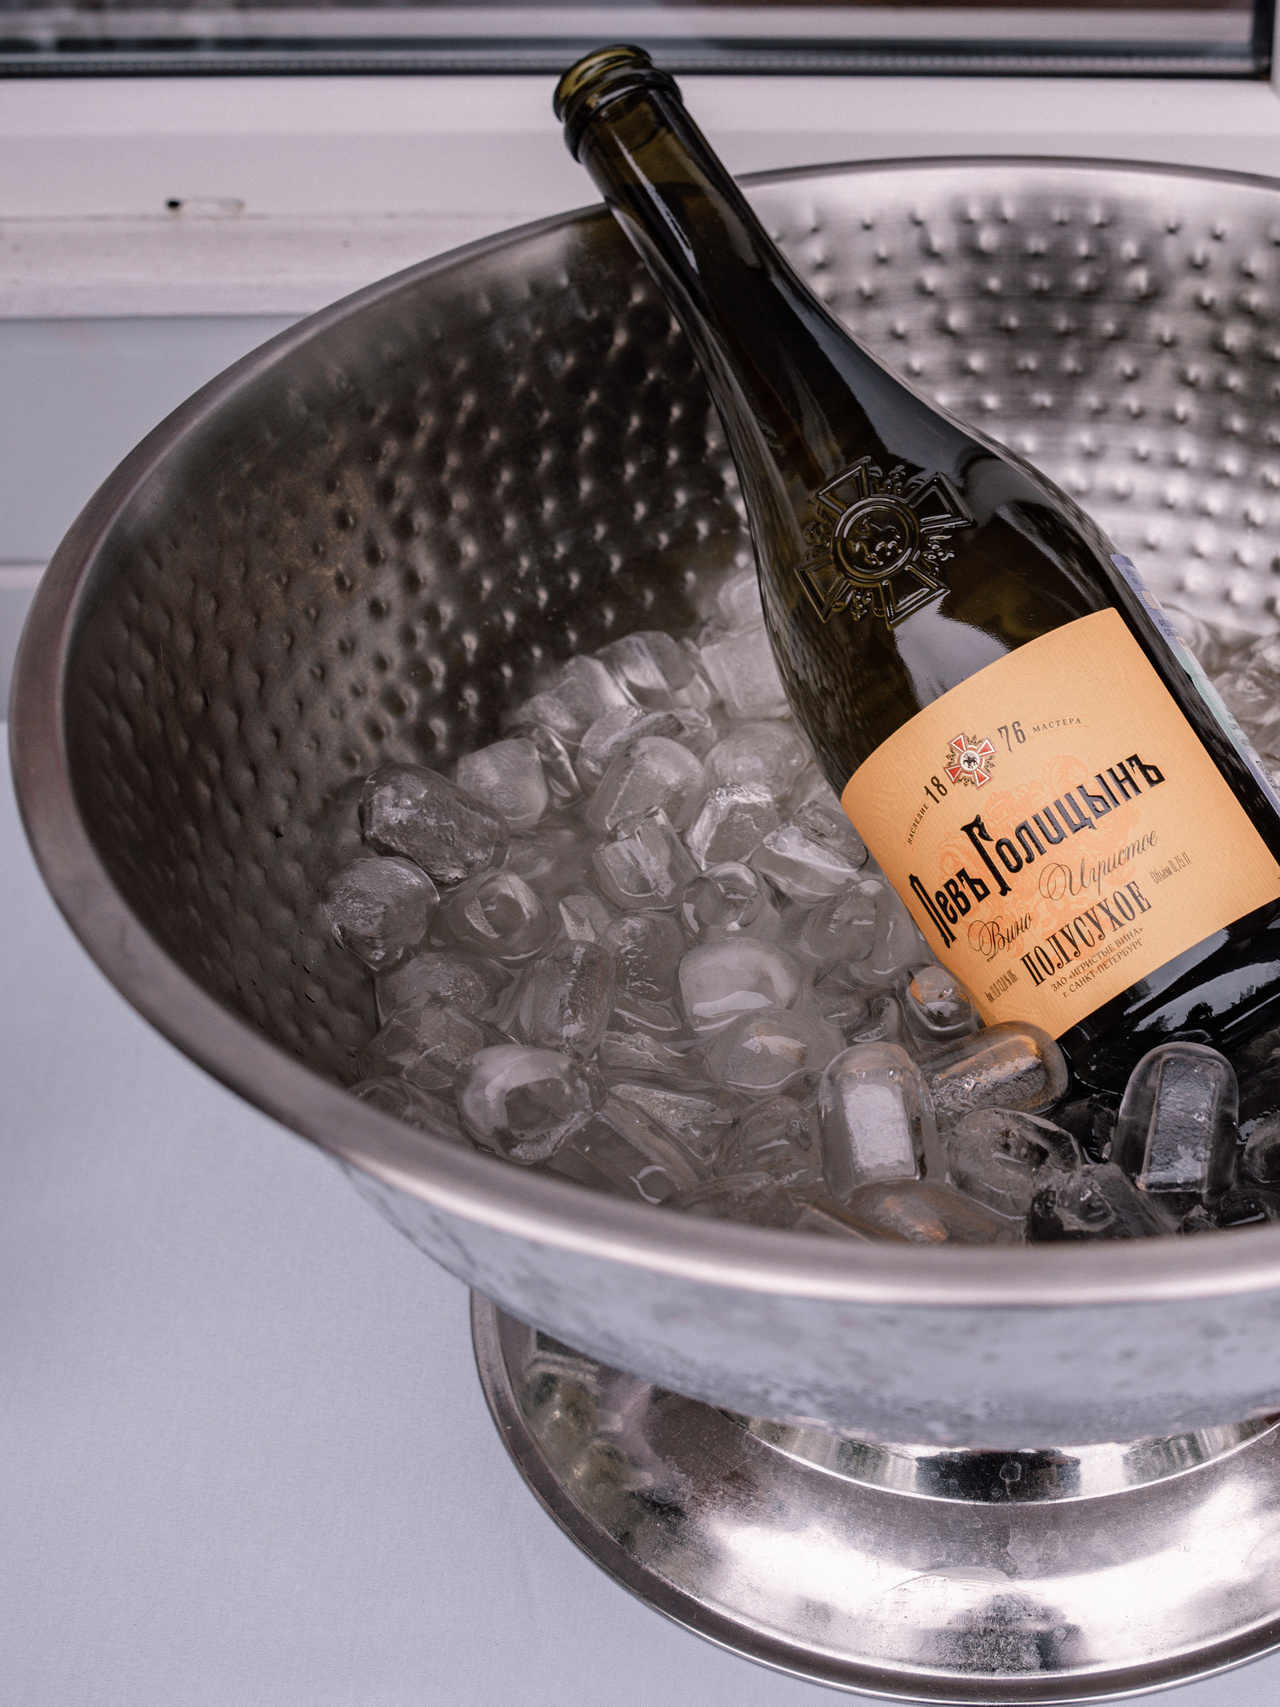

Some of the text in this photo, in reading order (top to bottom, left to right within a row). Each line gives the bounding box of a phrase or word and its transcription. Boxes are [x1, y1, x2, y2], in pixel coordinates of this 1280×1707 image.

[907, 717, 1082, 845] НАСЛЕДИЕ 18 76 МАСТЕРА
[909, 753, 1166, 949] Левъ Голицынъ
[967, 830, 1158, 963] Вино Игристое
[1148, 865, 1173, 884] Объём
[1167, 853, 1186, 873] 0,75
[1020, 880, 1153, 987] ПОЛУСУХОЕ
[1051, 927, 1143, 992] ЗАО «ИГРИСТЫЕ ВИНА»
[1069, 938, 1143, 993] САНКТ-ПЕТЕРБУРГ
